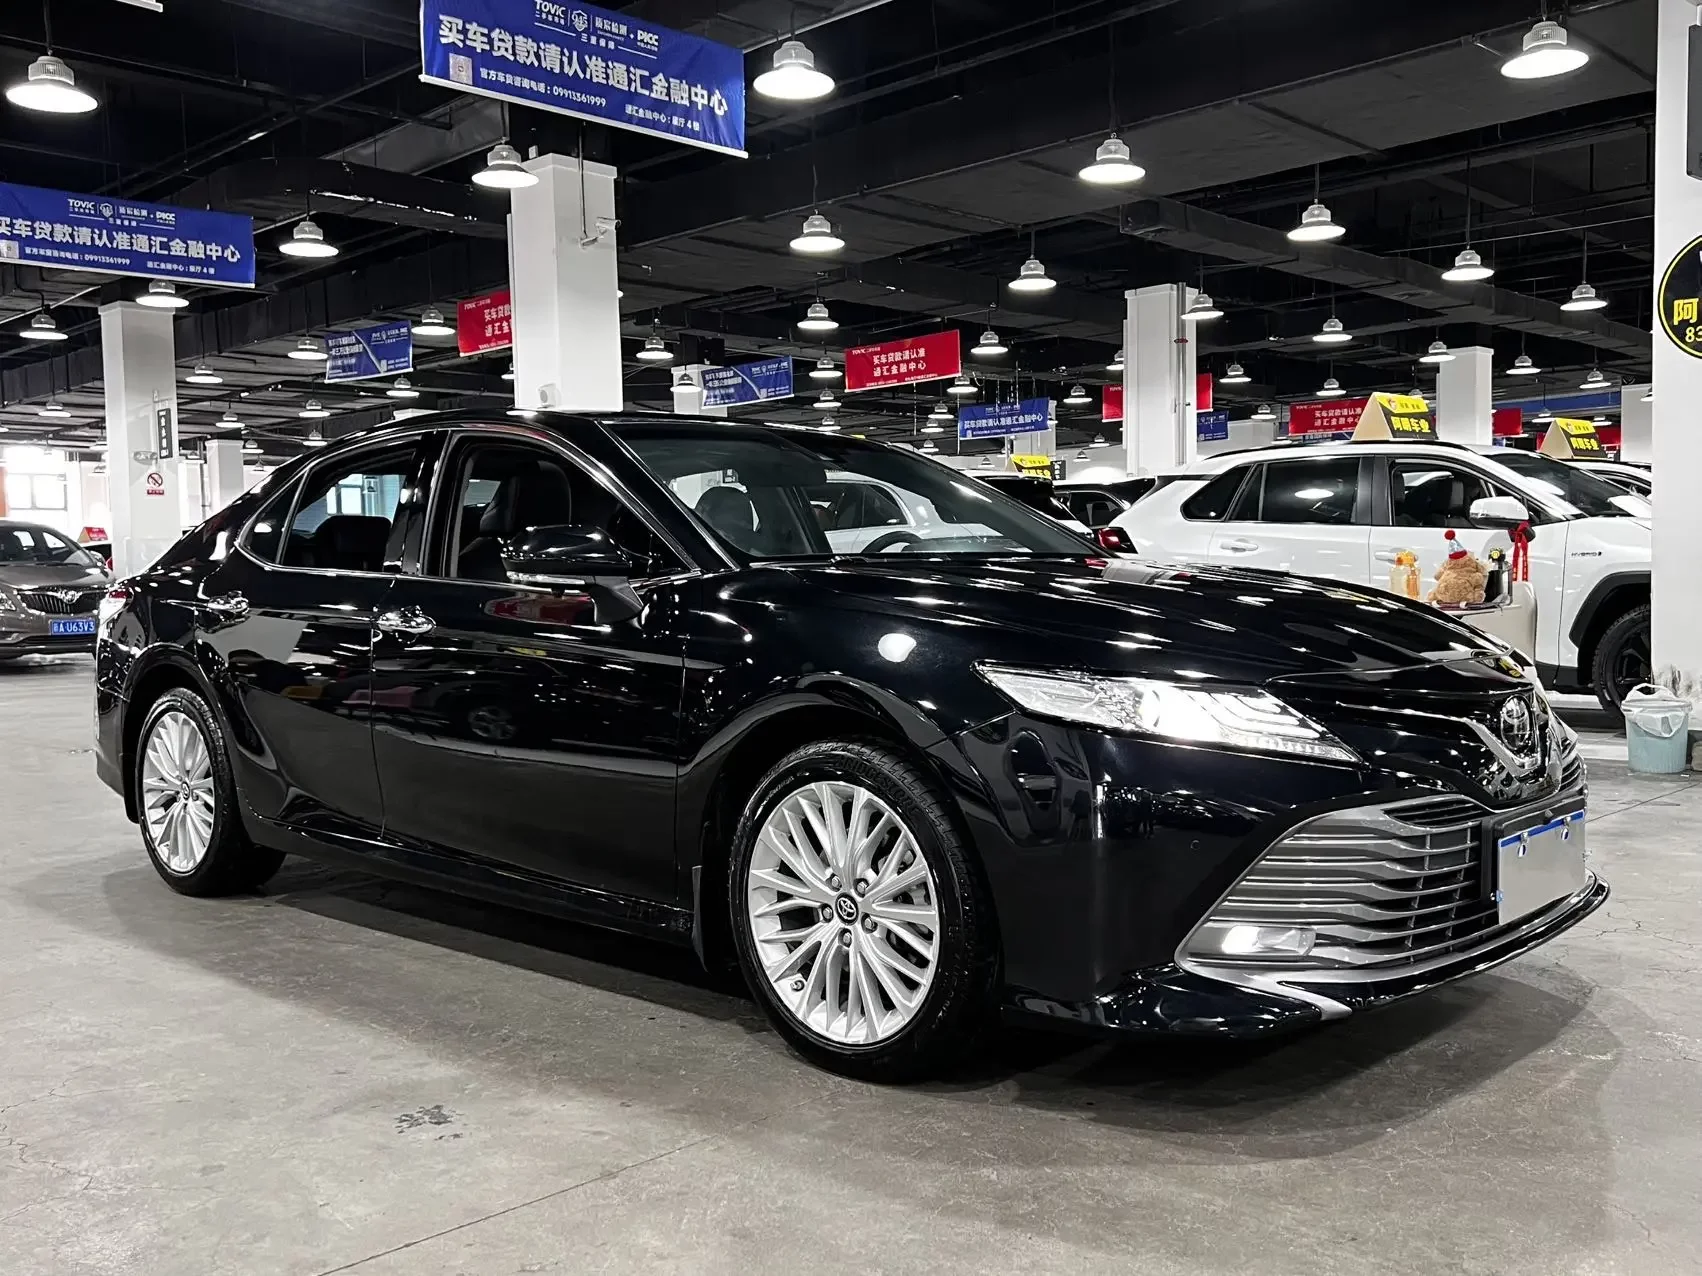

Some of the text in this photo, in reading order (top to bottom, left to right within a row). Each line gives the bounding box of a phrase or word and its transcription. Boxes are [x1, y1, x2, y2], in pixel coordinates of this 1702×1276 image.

[534, 0, 566, 17] TOVIC
[637, 30, 659, 46] PICC
[438, 14, 728, 116] 买车贷款请认准通汇金融中心
[67, 199, 95, 209] TOVIC
[0, 216, 241, 263] 买车贷款请认准通汇金融中心
[1673, 298, 1699, 325] 阿
[484, 319, 512, 337] 通汇金
[873, 347, 926, 366] 买车贷款请认准
[873, 360, 927, 377] 通汇金融中心
